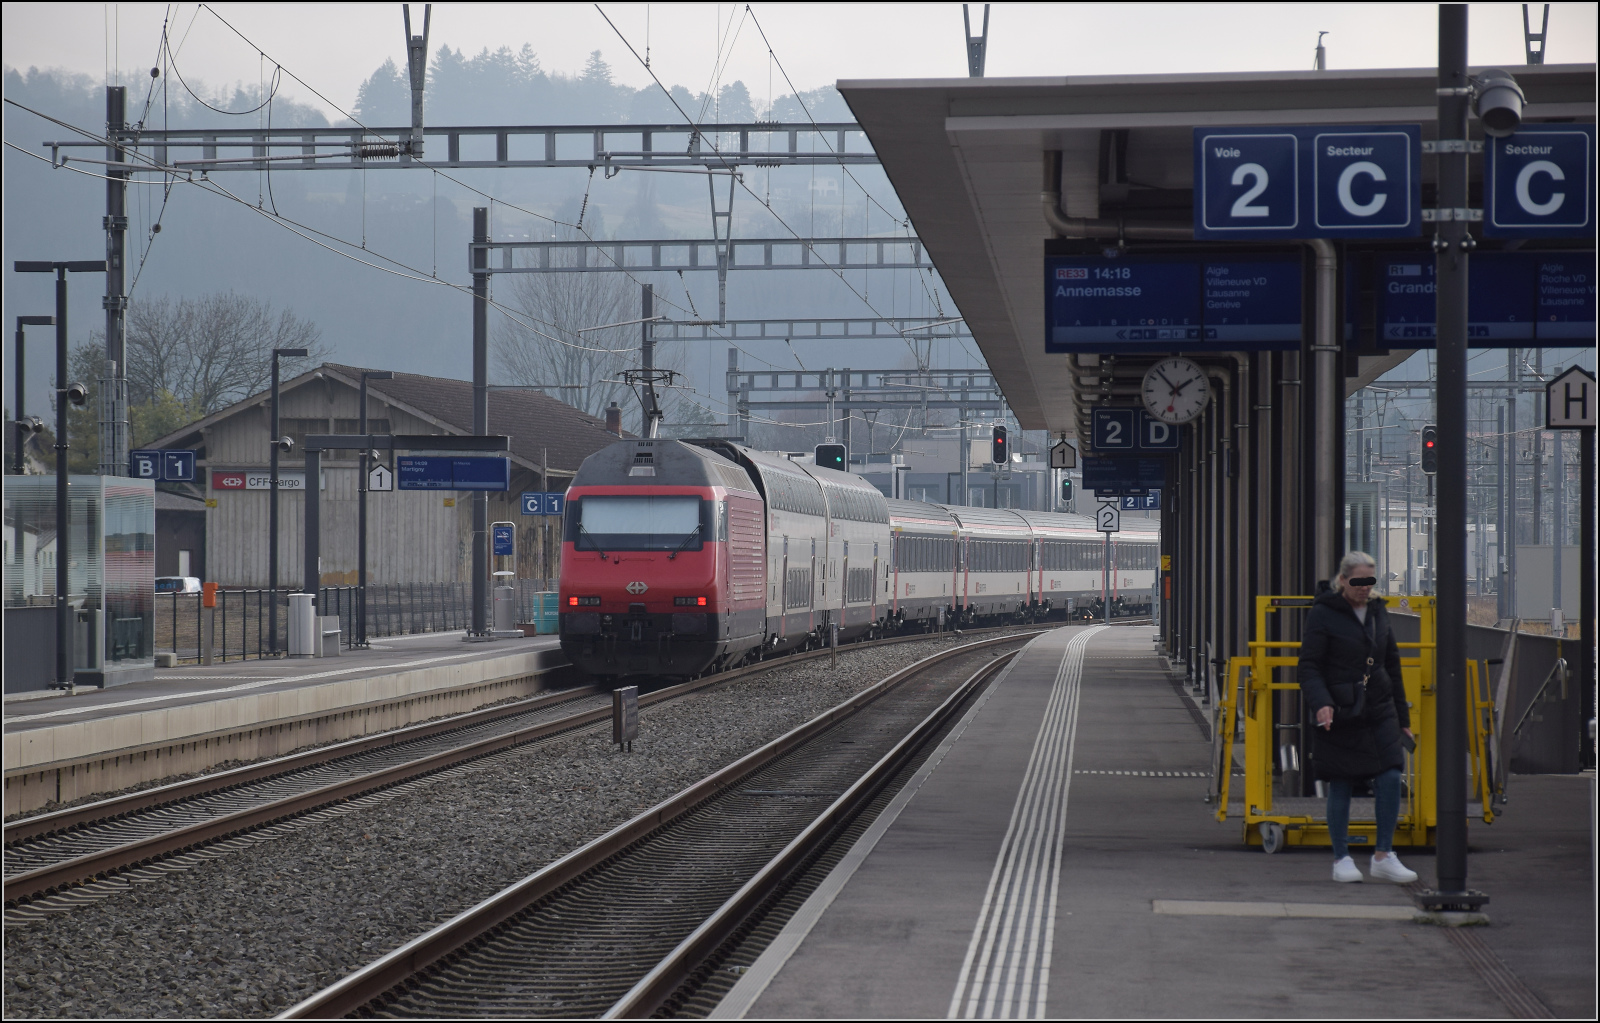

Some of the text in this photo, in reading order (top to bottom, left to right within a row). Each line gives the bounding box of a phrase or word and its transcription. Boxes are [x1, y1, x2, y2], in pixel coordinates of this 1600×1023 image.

[1214, 146, 1241, 159] Voie
[1326, 144, 1374, 157] Secteur
[1504, 143, 1553, 156] Secteur
[1230, 163, 1270, 218] 2
[1336, 160, 1388, 217] C
[1515, 159, 1566, 216] C
[1057, 267, 1131, 279] RE33 14:18
[1206, 265, 1229, 276] Aigle
[1390, 266, 1404, 275] R1
[1541, 263, 1564, 273] Aigle
[1206, 276, 1267, 287] Villeneuve VD
[1541, 274, 1586, 283] Roche VD
[1055, 285, 1142, 297] Annemasse
[1206, 288, 1250, 298] Lausanne
[1540, 285, 1587, 295] Villeneuve
[1206, 300, 1241, 309] Genève
[1540, 297, 1585, 306] Lausanne
[1565, 382, 1587, 419] H
[1105, 420, 1122, 444] 2
[1149, 421, 1170, 444] D
[1058, 448, 1065, 464] 1
[139, 460, 154, 477] B
[174, 460, 183, 477] 1
[248, 477, 300, 488] CFF argo
[376, 471, 383, 488] 1
[526, 499, 538, 512] C
[551, 499, 558, 512] 1
[1126, 496, 1135, 508] 2
[1146, 496, 1155, 507] F
[1102, 511, 1114, 528] 2
